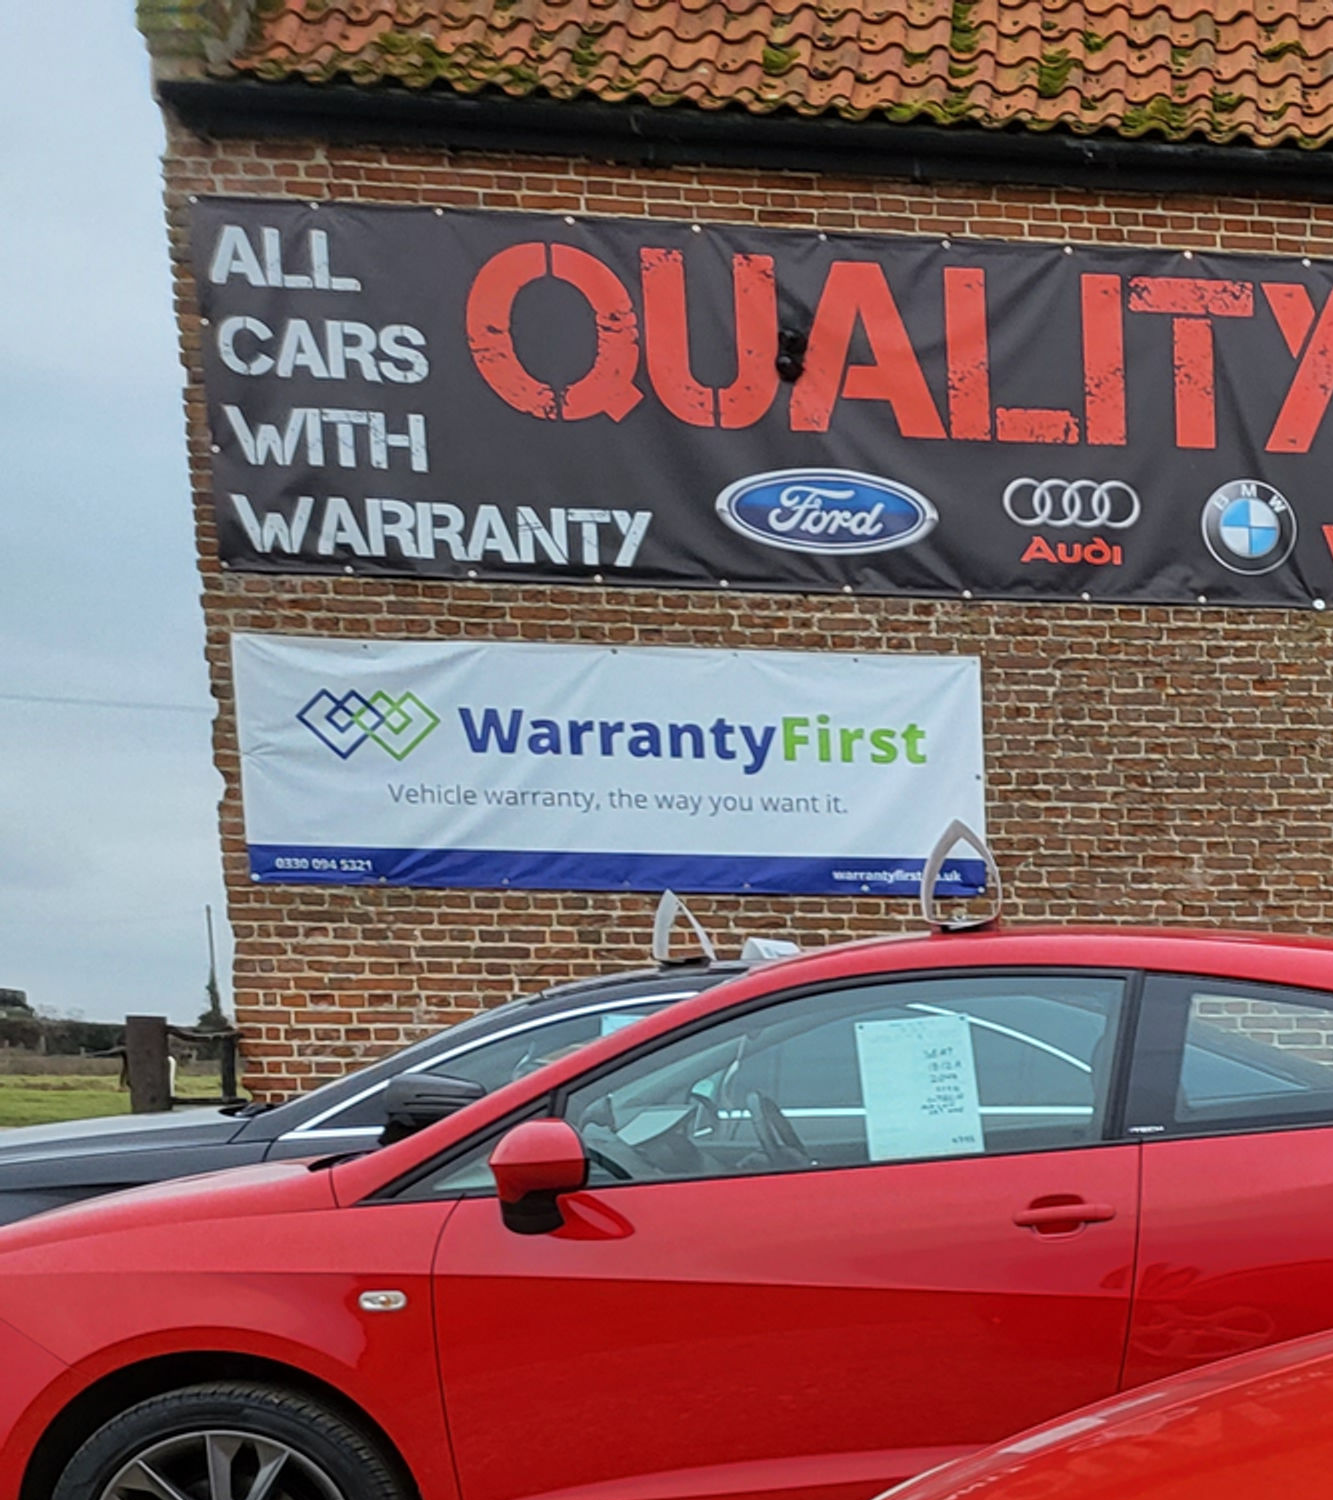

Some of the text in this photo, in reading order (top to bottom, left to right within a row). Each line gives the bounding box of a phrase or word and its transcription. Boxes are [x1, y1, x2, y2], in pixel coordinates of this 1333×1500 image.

[210, 224, 362, 292] ALL
[217, 315, 430, 385] CARS
[224, 403, 429, 474] WITH
[767, 486, 886, 538] Ford
[1212, 483, 1287, 513] BMW
[230, 492, 654, 568] WARRANTY
[1020, 535, 1123, 566] Audi
[458, 706, 928, 775] WarrantyFirst
[388, 783, 848, 818] Vehicle warranty, the way you want it.
[275, 857, 310, 870] 0330
